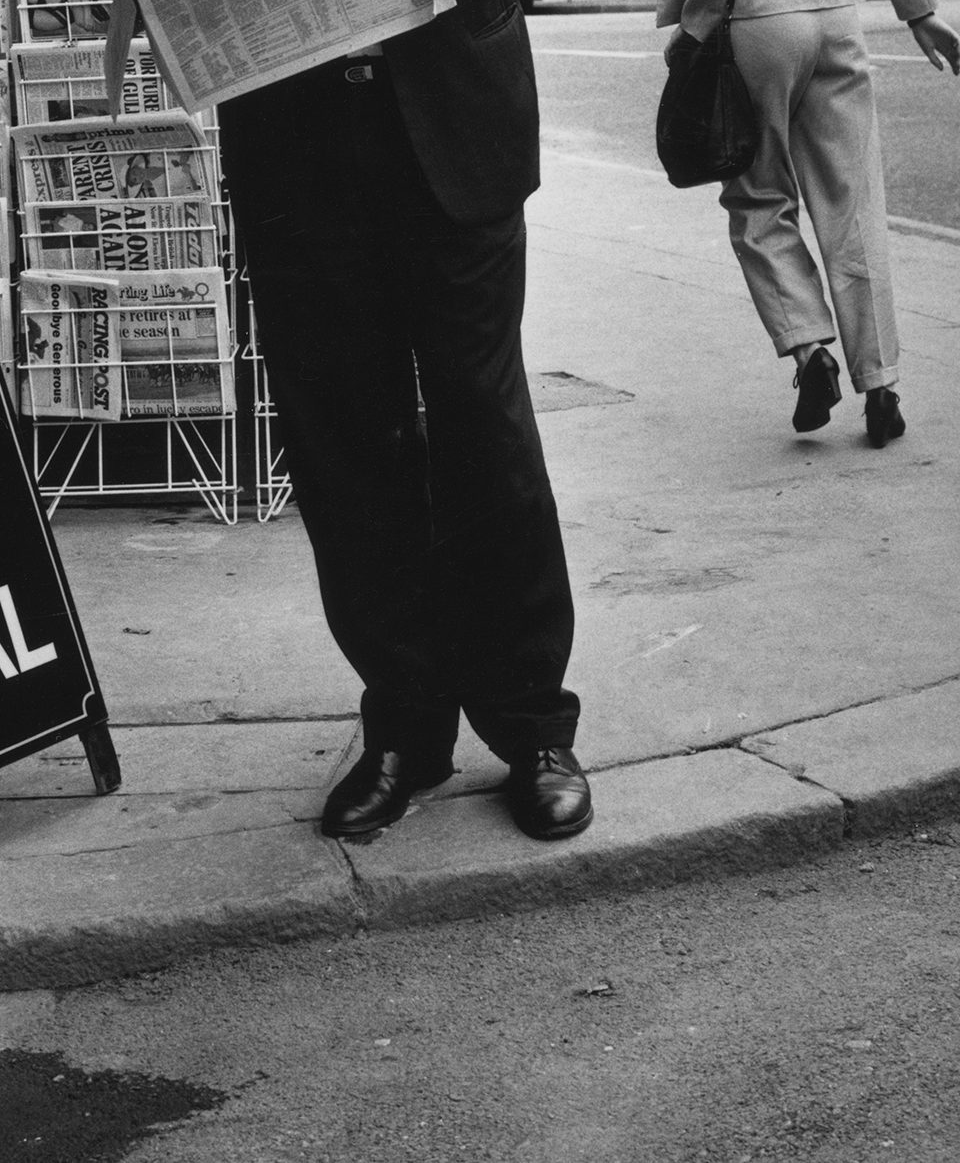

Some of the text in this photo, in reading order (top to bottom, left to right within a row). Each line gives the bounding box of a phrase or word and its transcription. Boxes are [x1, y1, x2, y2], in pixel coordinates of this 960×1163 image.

[138, 50, 160, 113] TORTURE
[87, 123, 175, 141] prime time
[184, 202, 203, 268] Toda
[152, 283, 176, 299] Life
[129, 307, 191, 322] retires at
[134, 325, 180, 339] season
[91, 286, 110, 411] RACING POST
[143, 404, 154, 415] in
